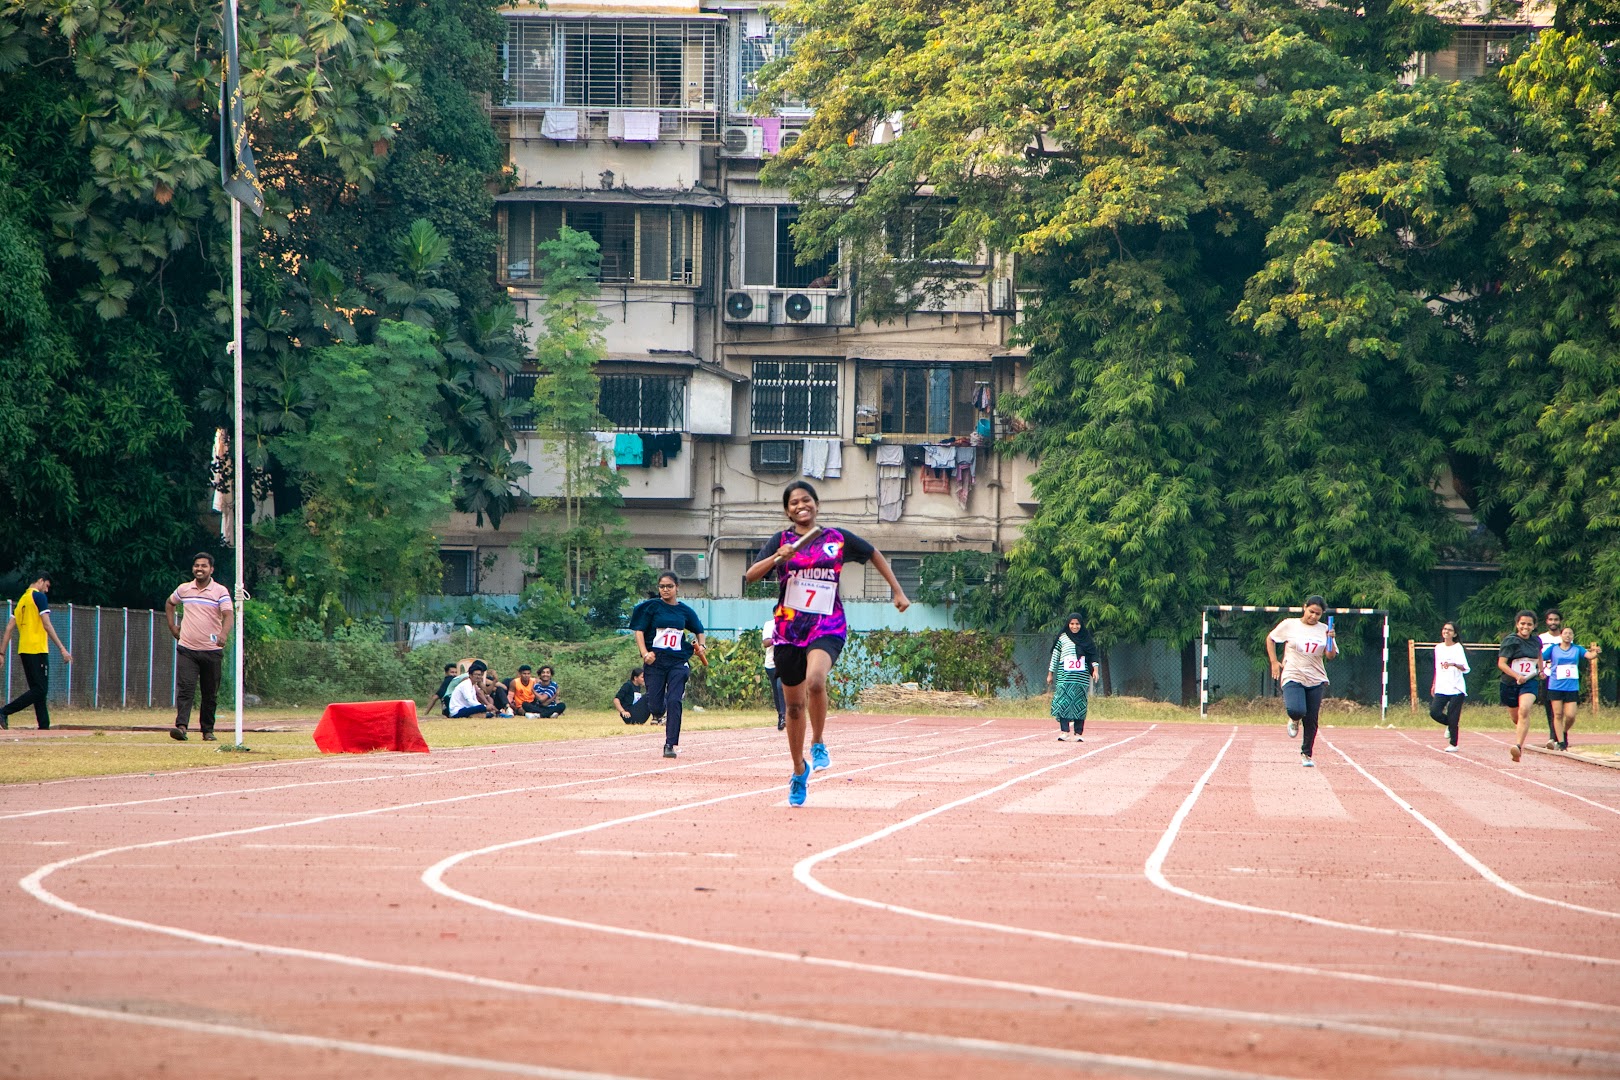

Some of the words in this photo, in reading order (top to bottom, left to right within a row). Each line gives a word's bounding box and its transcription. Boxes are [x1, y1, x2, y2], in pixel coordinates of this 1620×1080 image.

[805, 589, 816, 608] 7
[663, 633, 677, 648] 10
[1304, 642, 1319, 654] 17
[1068, 660, 1081, 669] 20
[1519, 662, 1531, 673] 12
[1565, 668, 1571, 678] 9
